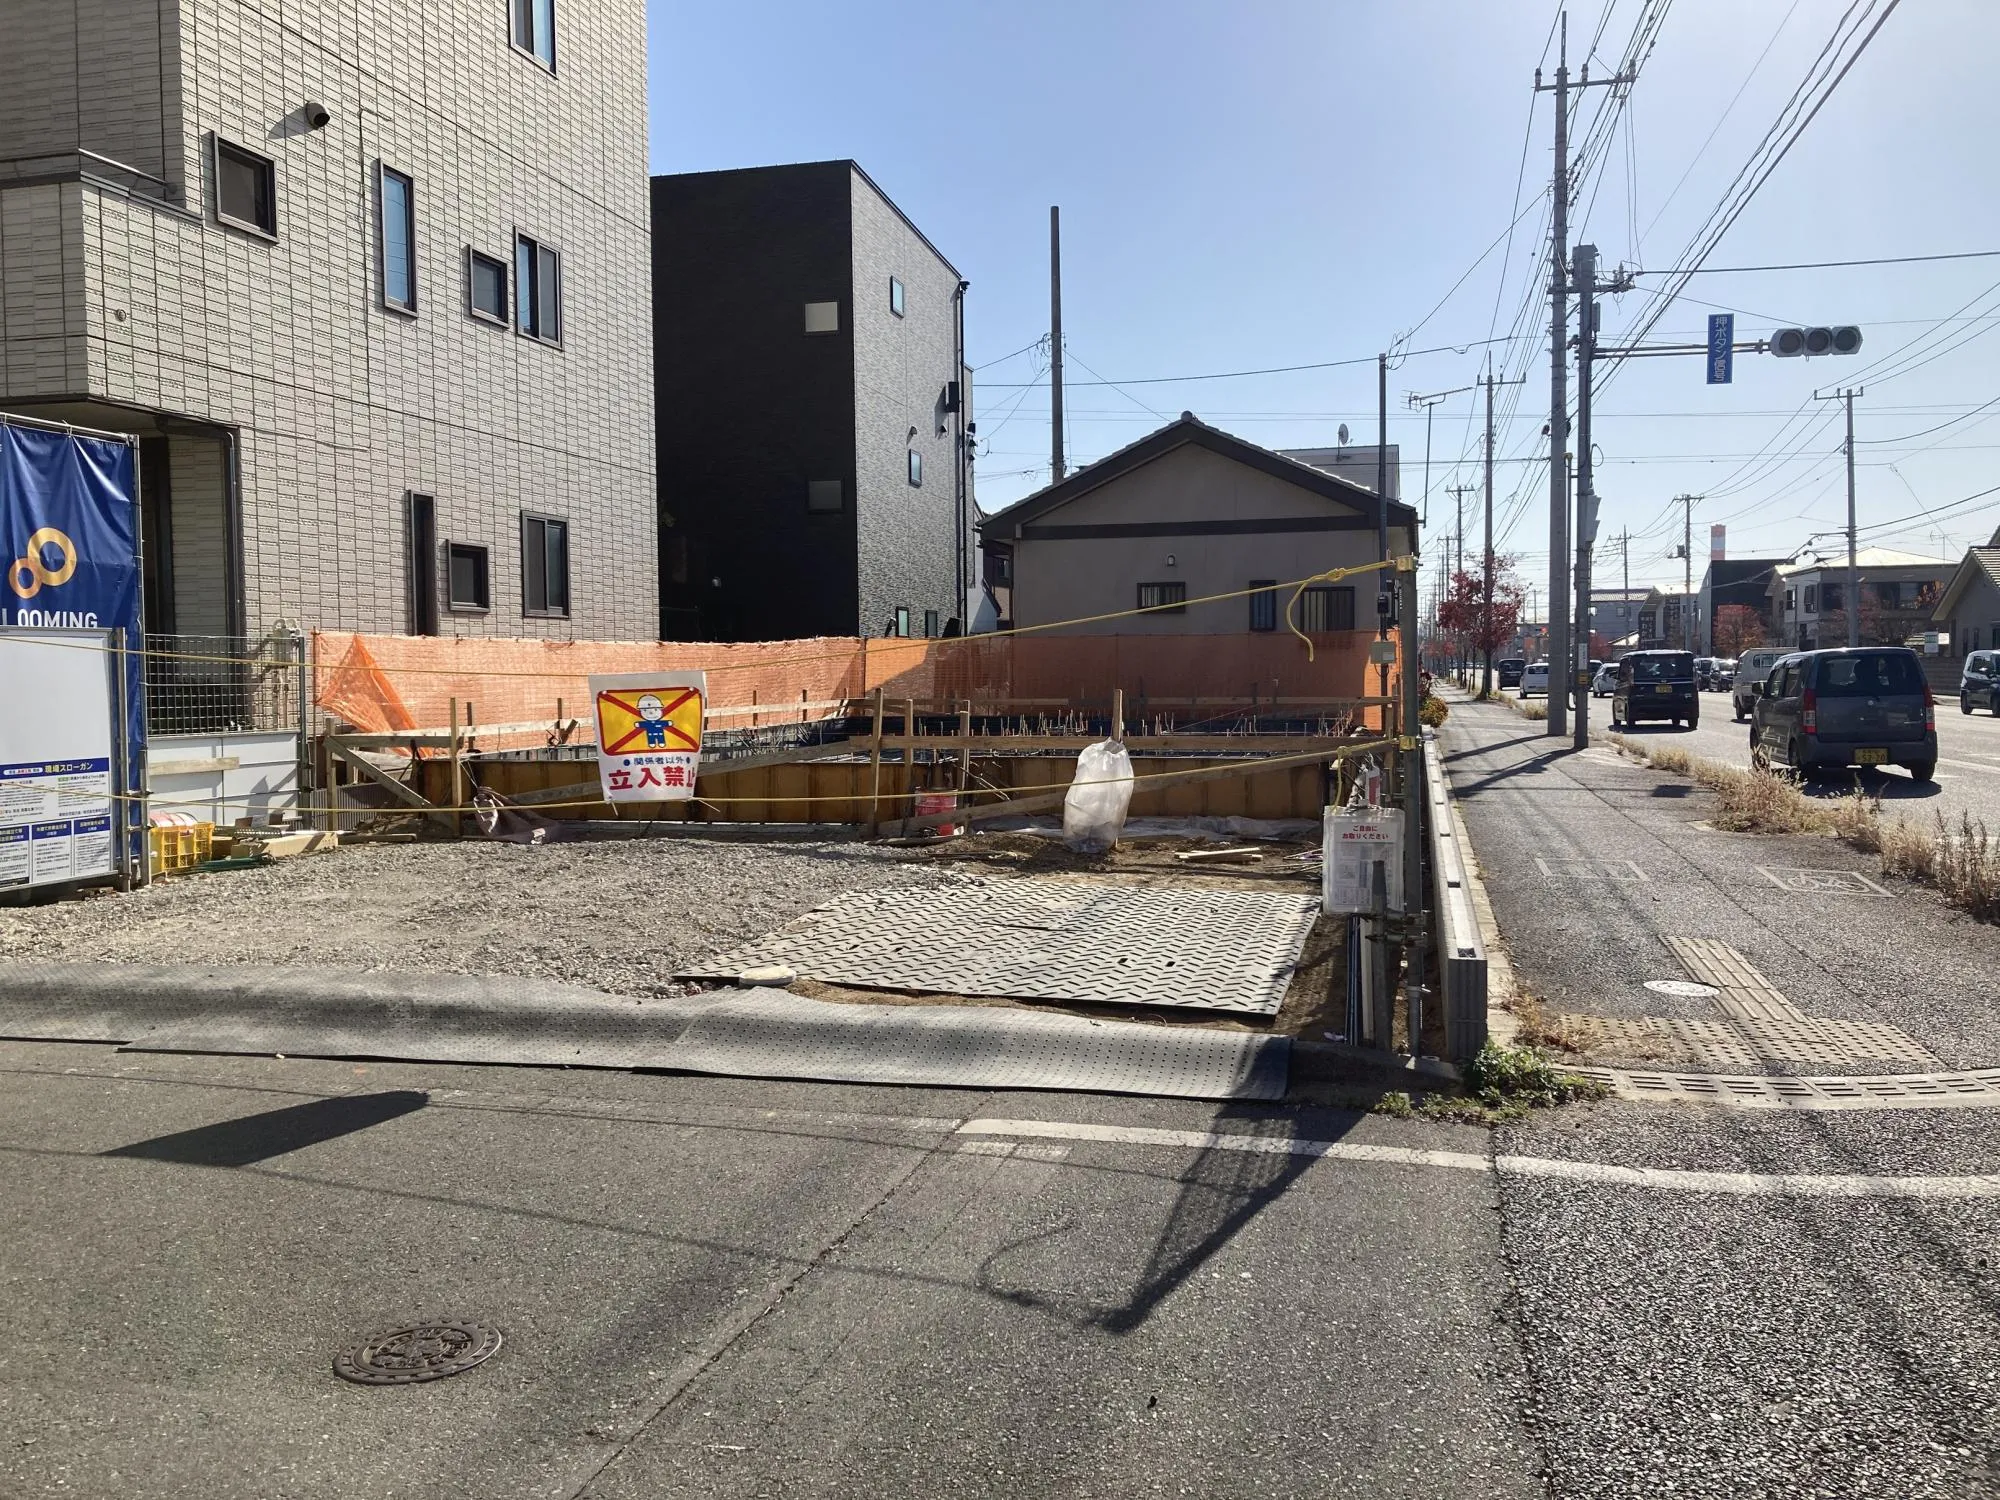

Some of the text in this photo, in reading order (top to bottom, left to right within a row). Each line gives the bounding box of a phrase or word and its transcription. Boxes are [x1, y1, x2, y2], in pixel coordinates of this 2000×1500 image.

[633, 756, 684, 765] 関係者以外
